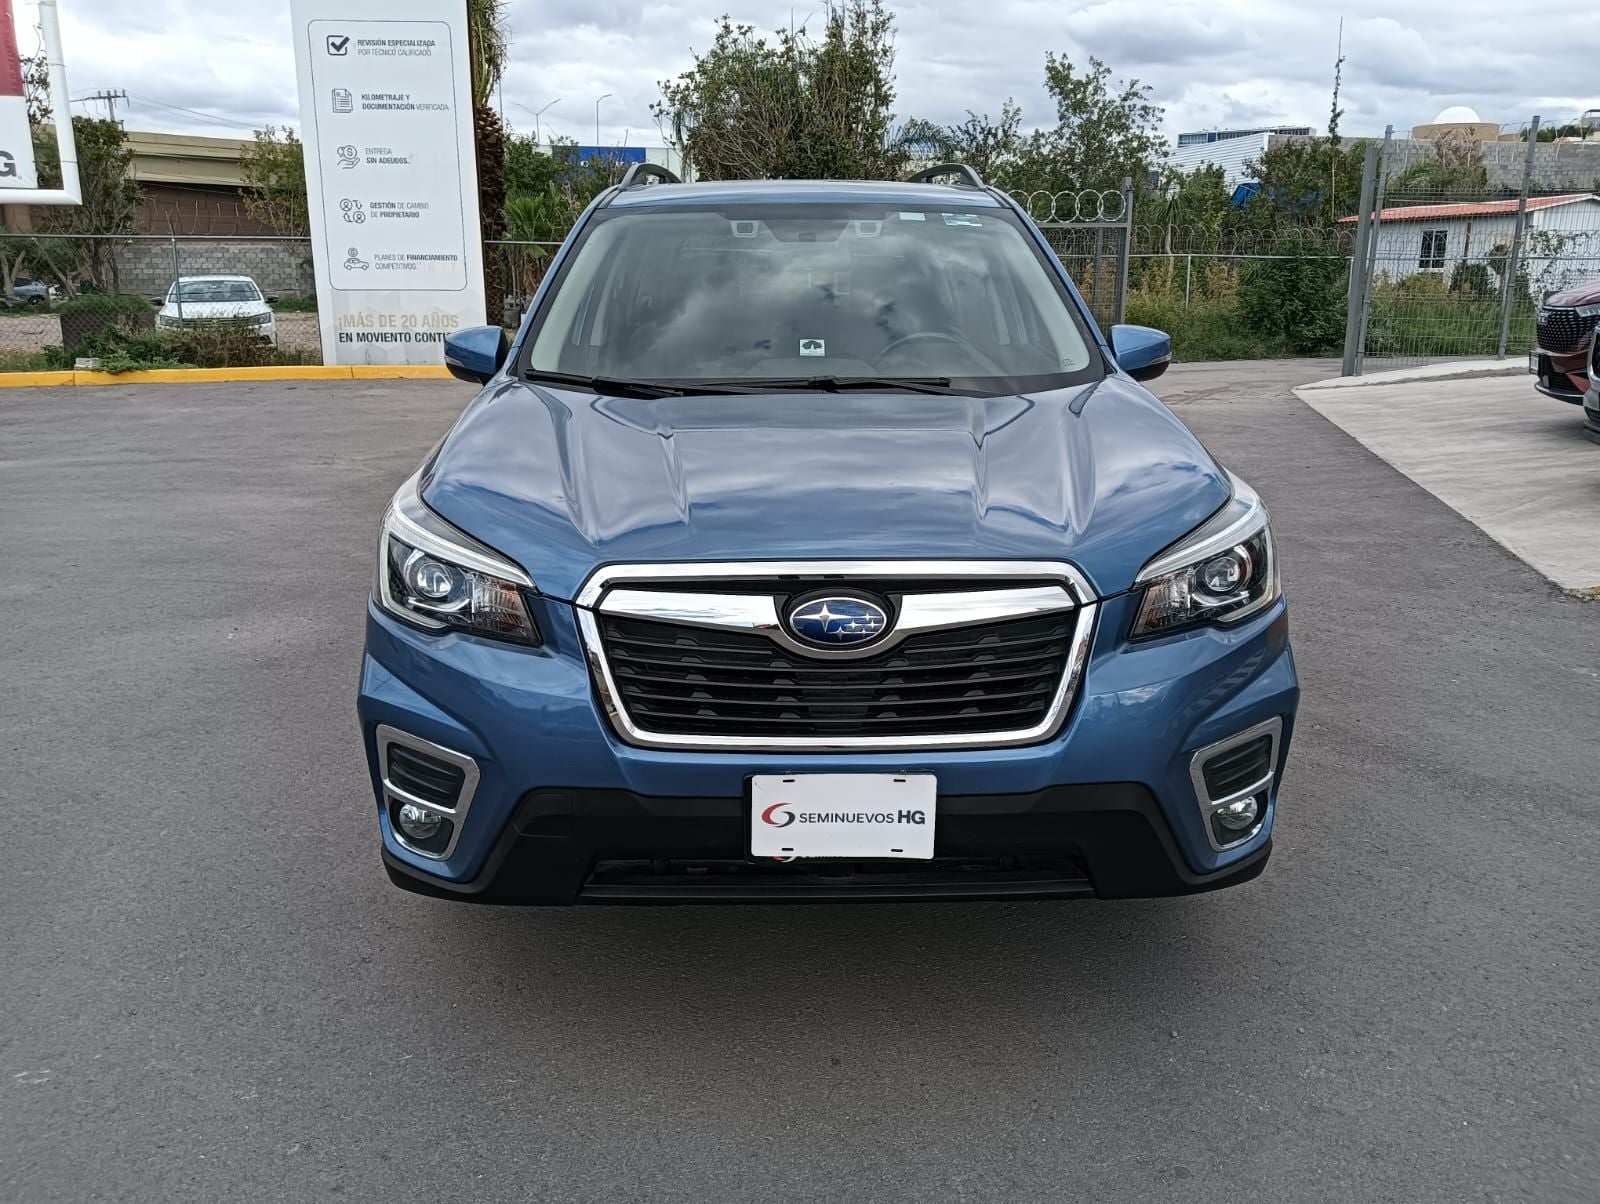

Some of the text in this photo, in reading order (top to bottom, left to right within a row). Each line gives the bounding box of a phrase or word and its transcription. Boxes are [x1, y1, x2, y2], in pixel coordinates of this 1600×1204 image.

[357, 38, 436, 47] REVISIÓN ESPECIALIZADA
[358, 48, 371, 56] POR
[361, 93, 410, 101] KILOMETRAJE Y
[362, 102, 450, 111] DOCUMENTACIÓN VERIFICADA
[365, 147, 392, 155] ENTREGA
[366, 157, 377, 165] SIN
[369, 200, 430, 210] GESTIÓN DE CAMBIO
[371, 210, 420, 219] DE PROPIETARIO
[406, 254, 458, 262] FINANCIAMIENTO
[379, 314, 397, 328] DE
[400, 314, 417, 328] 20
[421, 312, 460, 328] AÑOS
[338, 331, 452, 344] EN MOVIENTO CONTI
[799, 810, 926, 825] SEMINUEVOS HG
